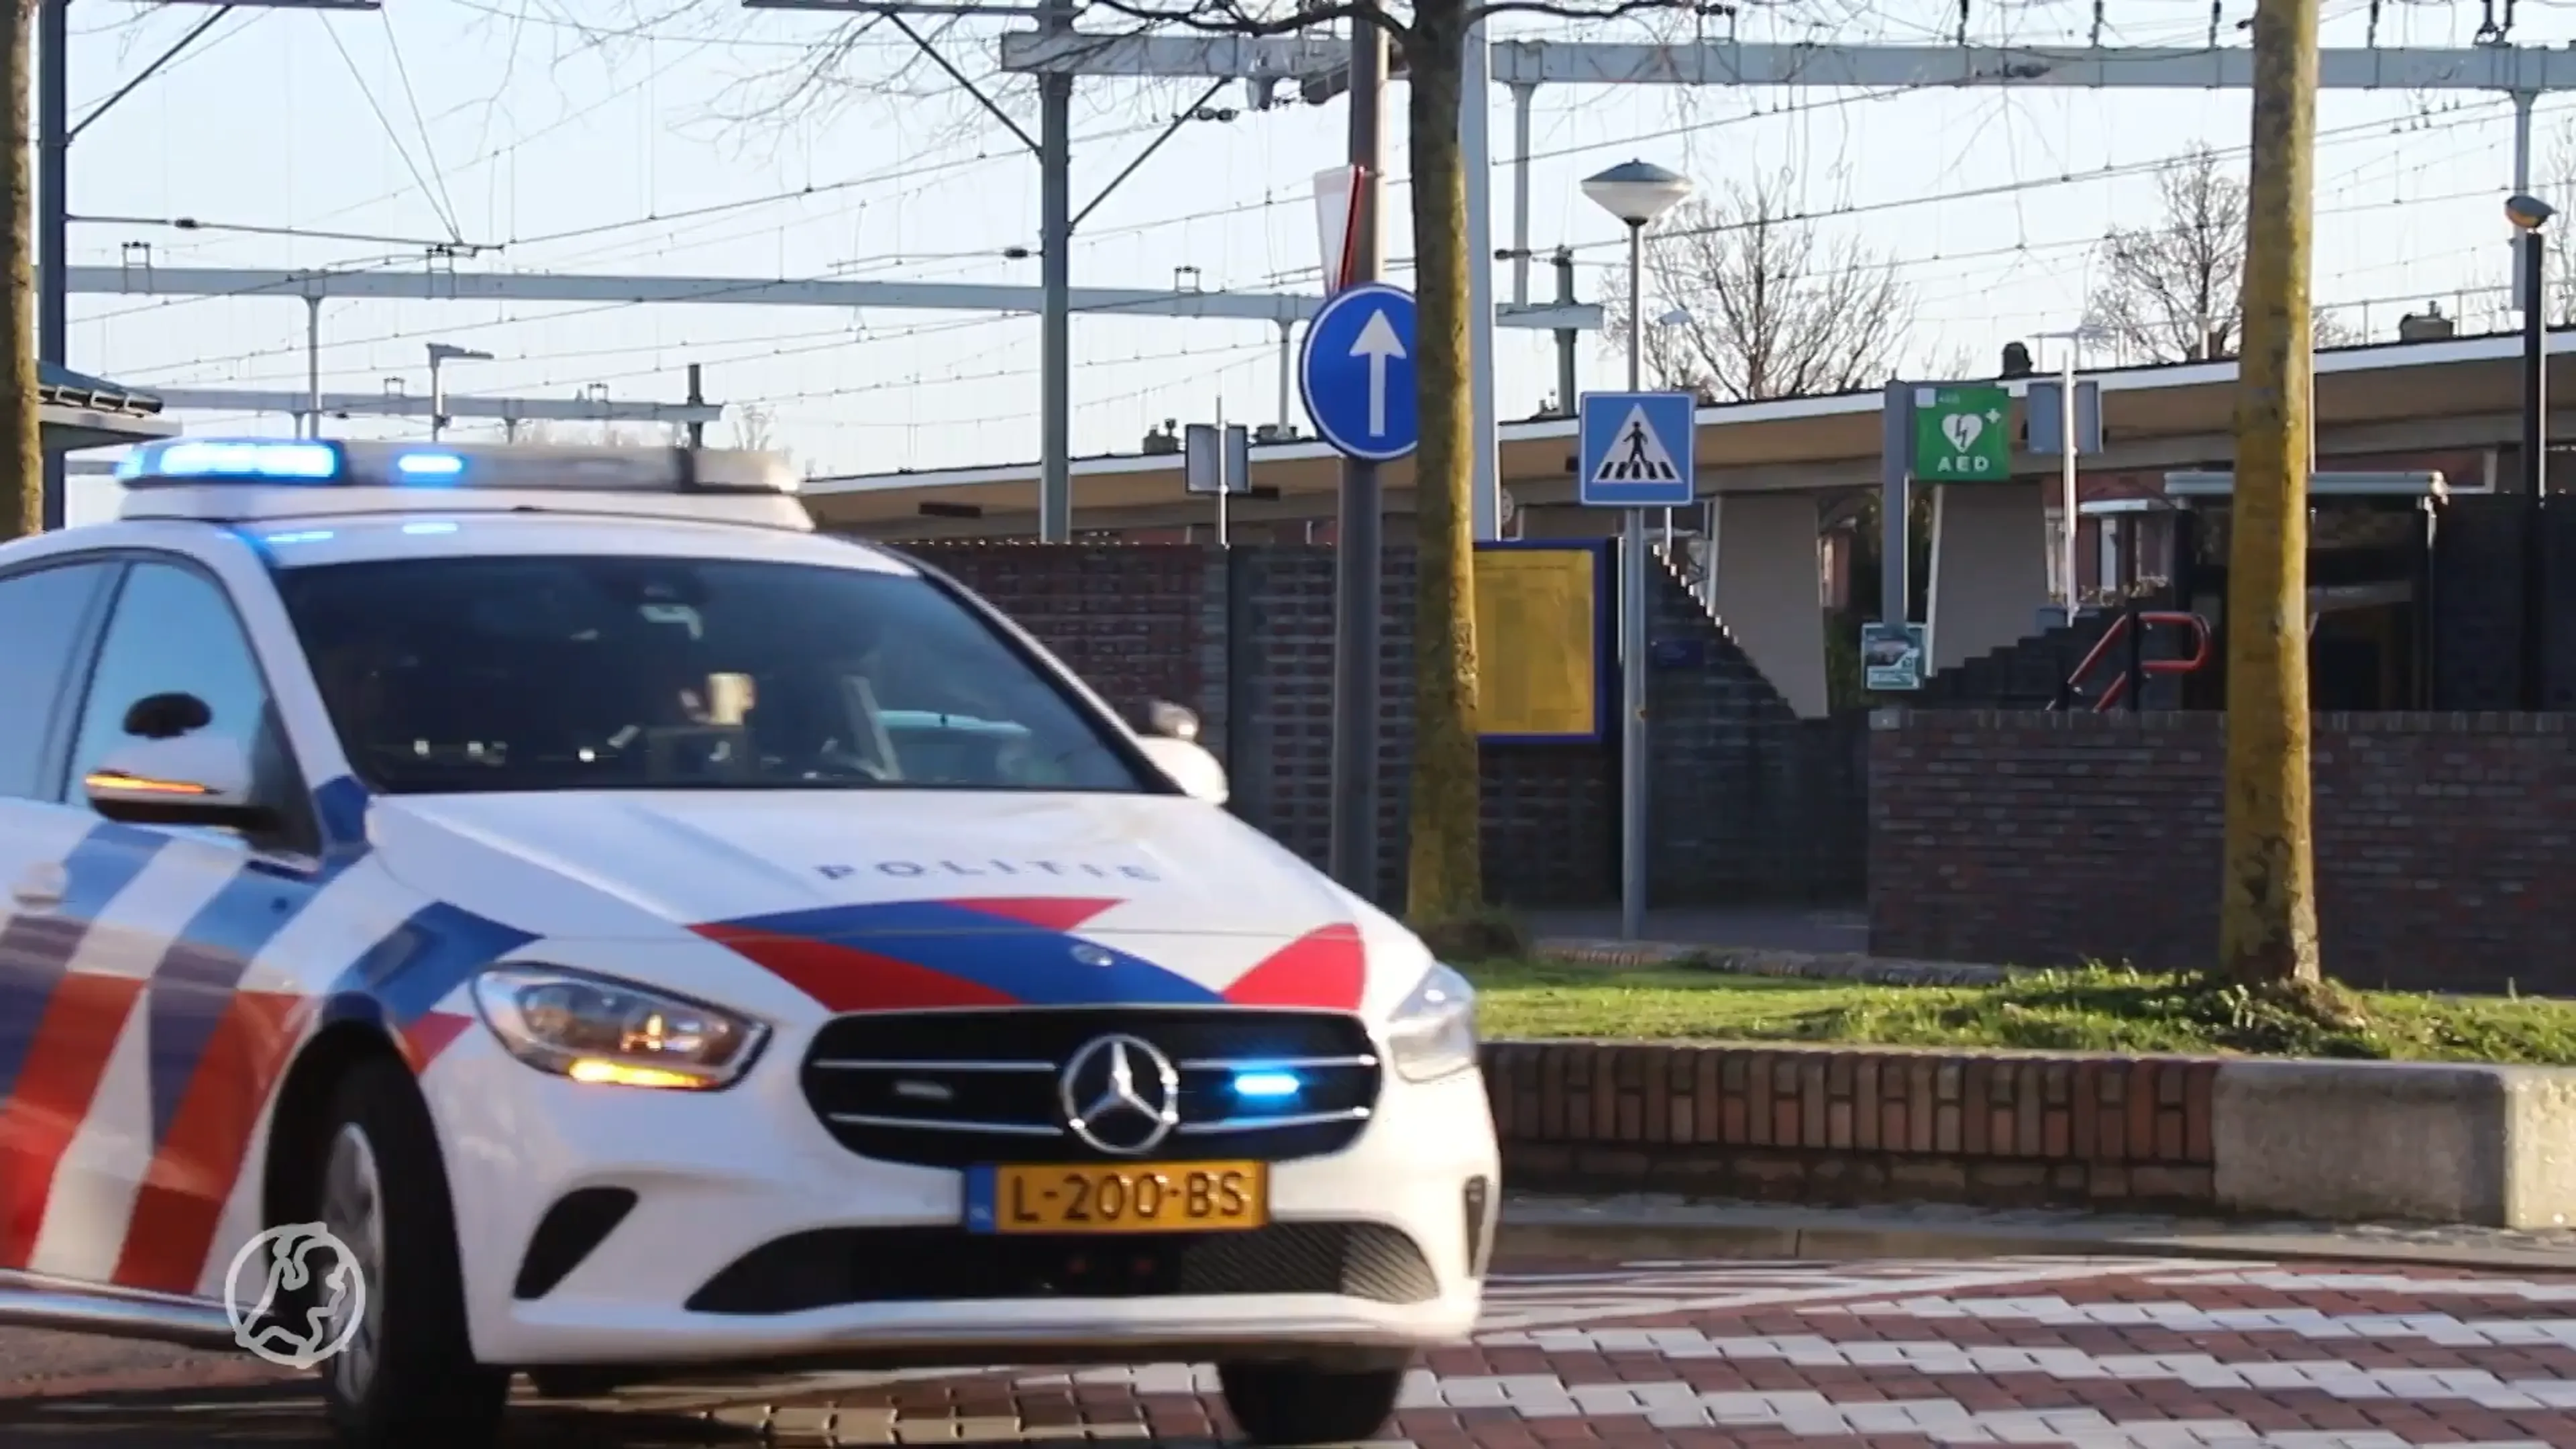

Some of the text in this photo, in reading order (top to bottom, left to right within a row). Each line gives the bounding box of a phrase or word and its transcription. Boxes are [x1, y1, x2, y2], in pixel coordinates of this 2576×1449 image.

[1937, 455, 1989, 472] AED
[814, 860, 1161, 881] POLITIE
[1013, 1171, 1246, 1222] L-200-BS
